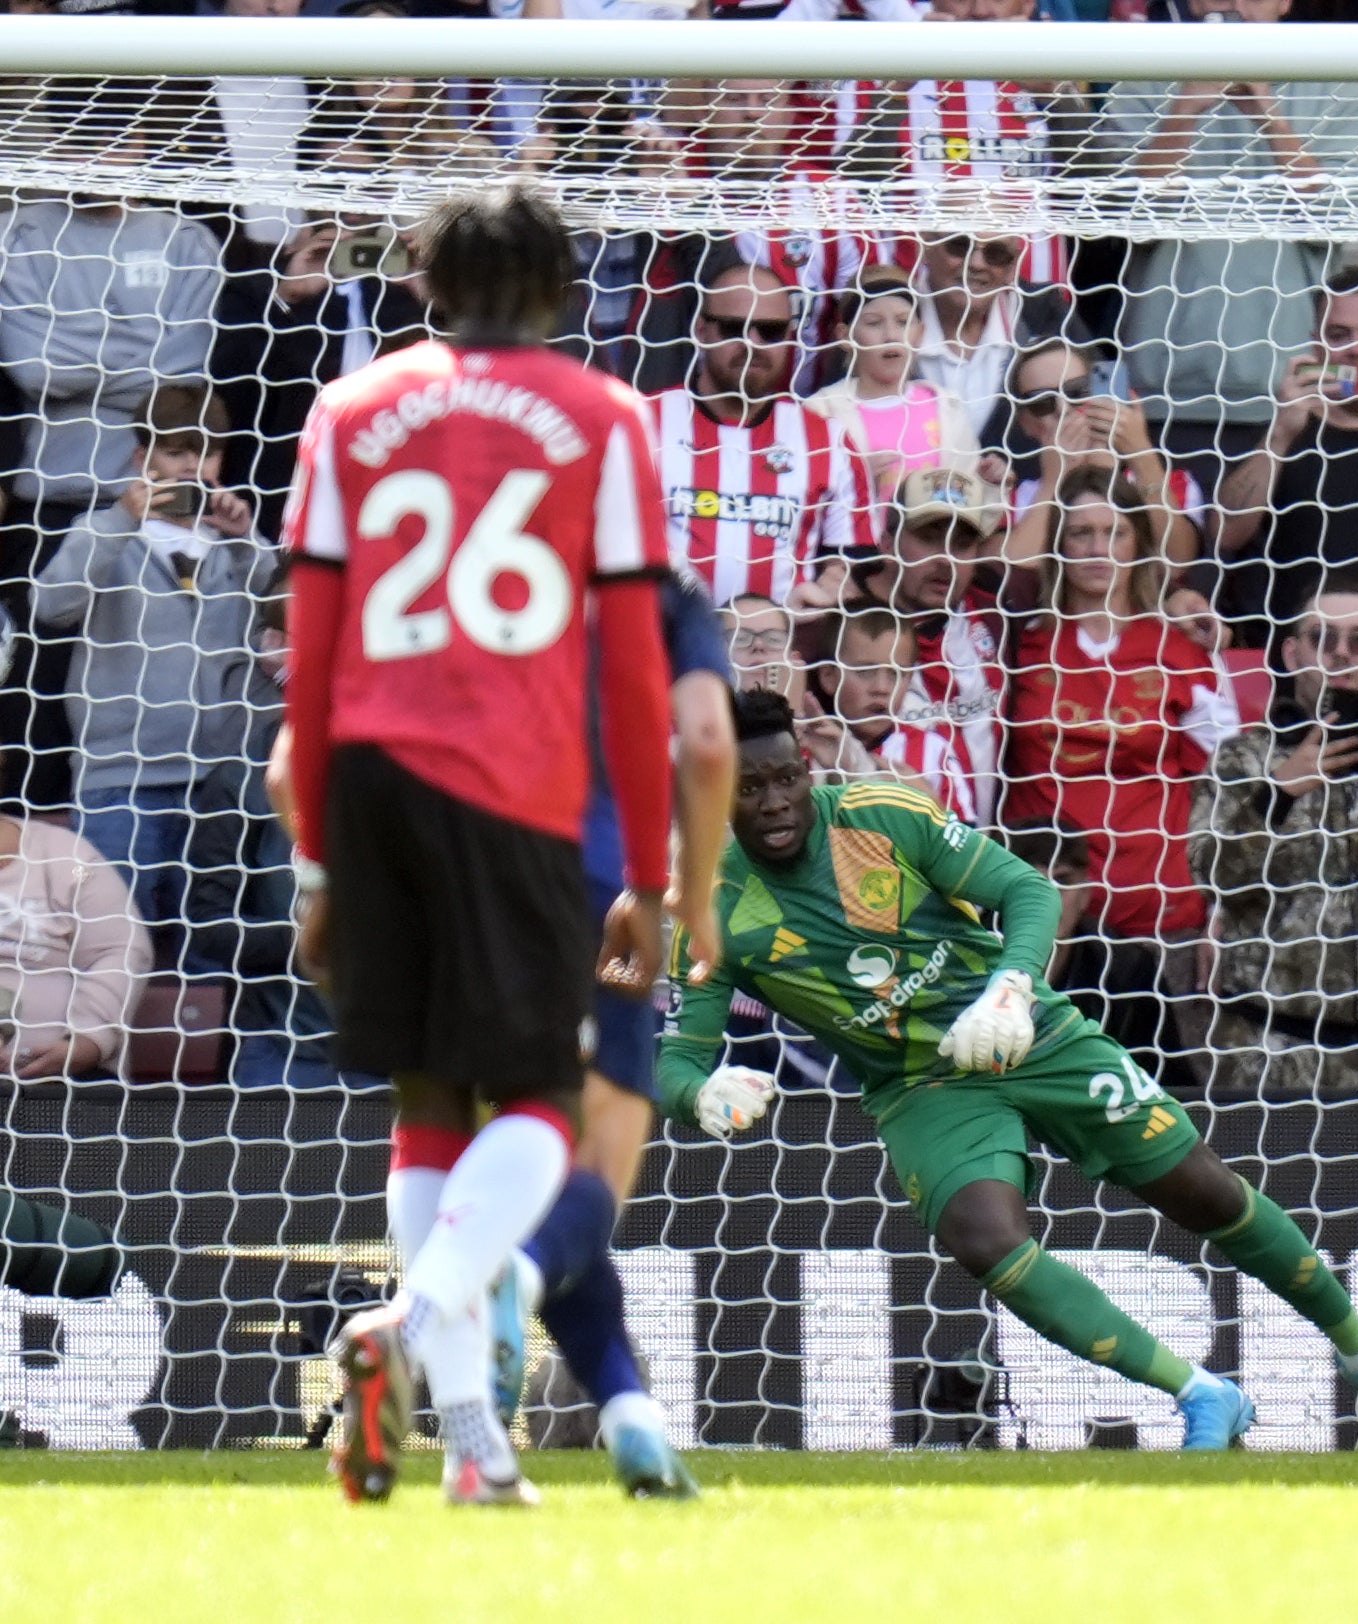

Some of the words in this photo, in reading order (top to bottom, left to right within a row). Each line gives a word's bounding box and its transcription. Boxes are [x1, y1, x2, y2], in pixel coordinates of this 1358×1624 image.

[921, 135, 1046, 163] ROLLBIT
[347, 377, 591, 469] UGOCHUKWU
[672, 489, 799, 526] ROLLBIT
[357, 468, 575, 662] 26
[832, 939, 953, 1030] Snapdragon
[1088, 1056, 1165, 1124] 24
